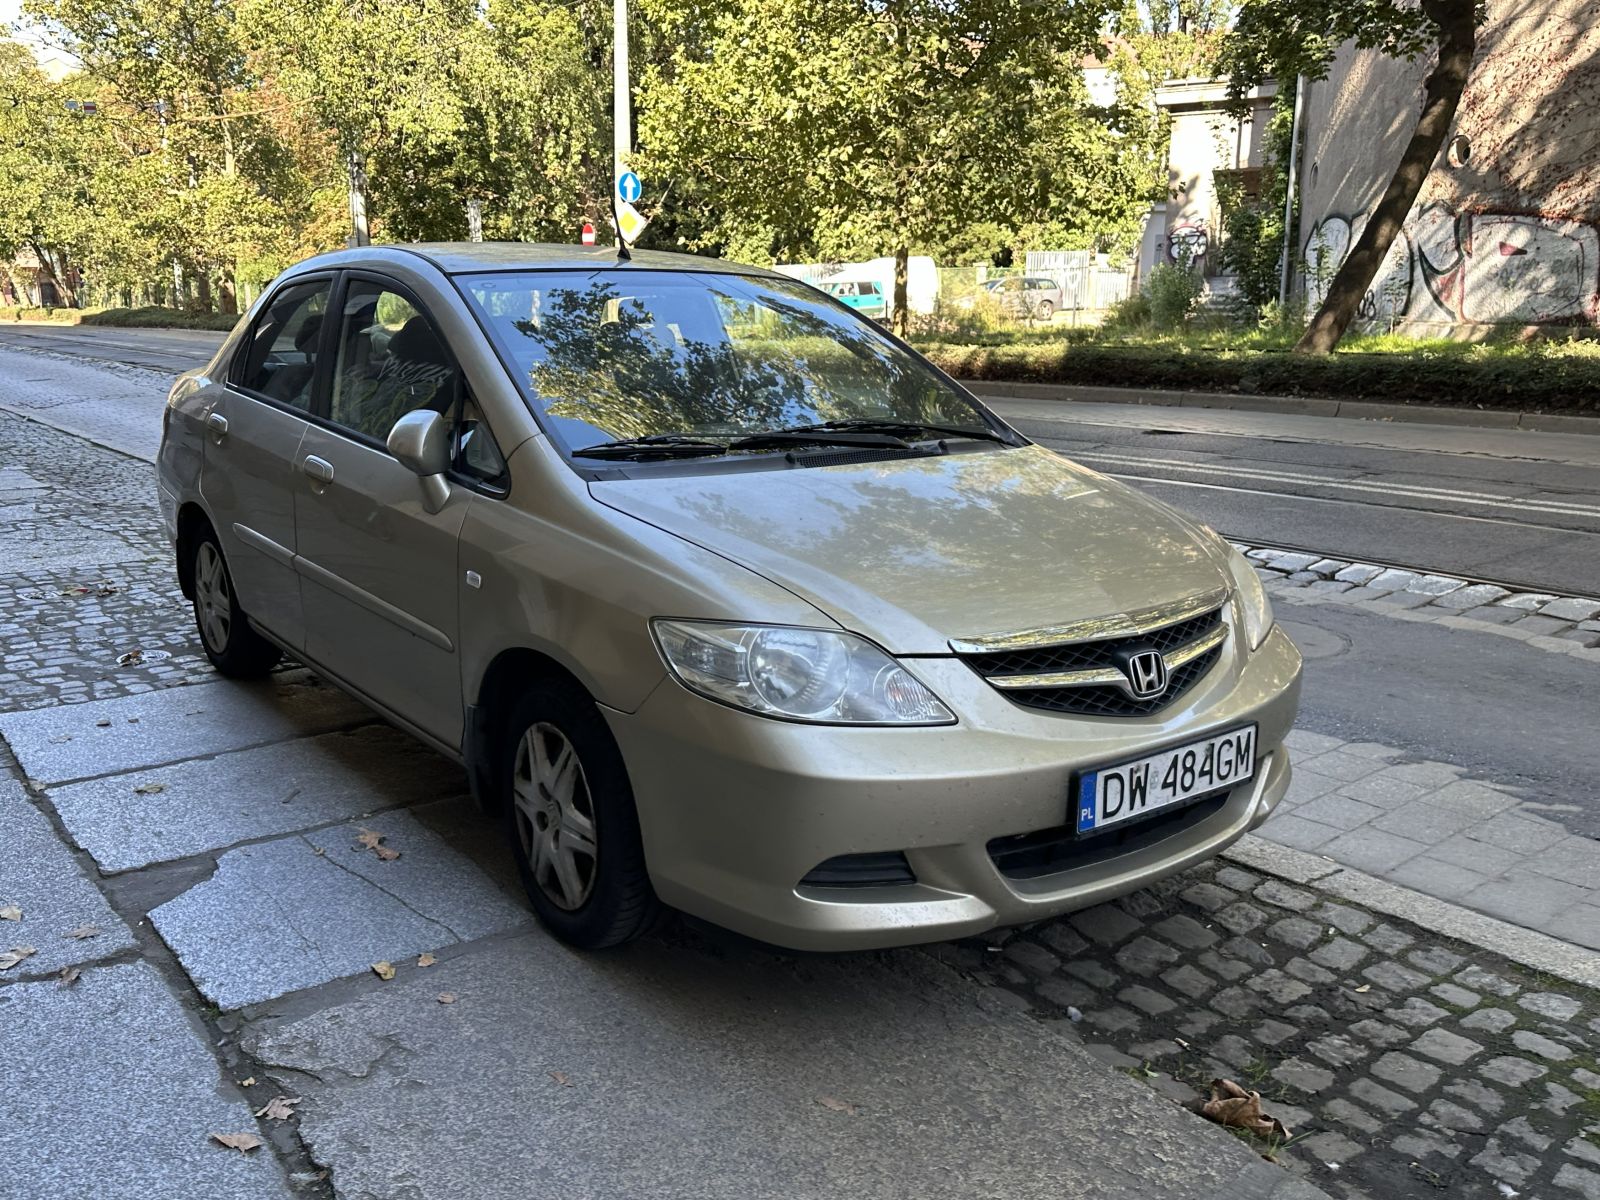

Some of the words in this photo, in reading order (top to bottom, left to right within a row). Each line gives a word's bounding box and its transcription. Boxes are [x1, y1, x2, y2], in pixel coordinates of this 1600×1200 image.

[1102, 763, 1150, 819] DW
[1161, 731, 1252, 797] 484GM
[1081, 807, 1094, 821] PL
